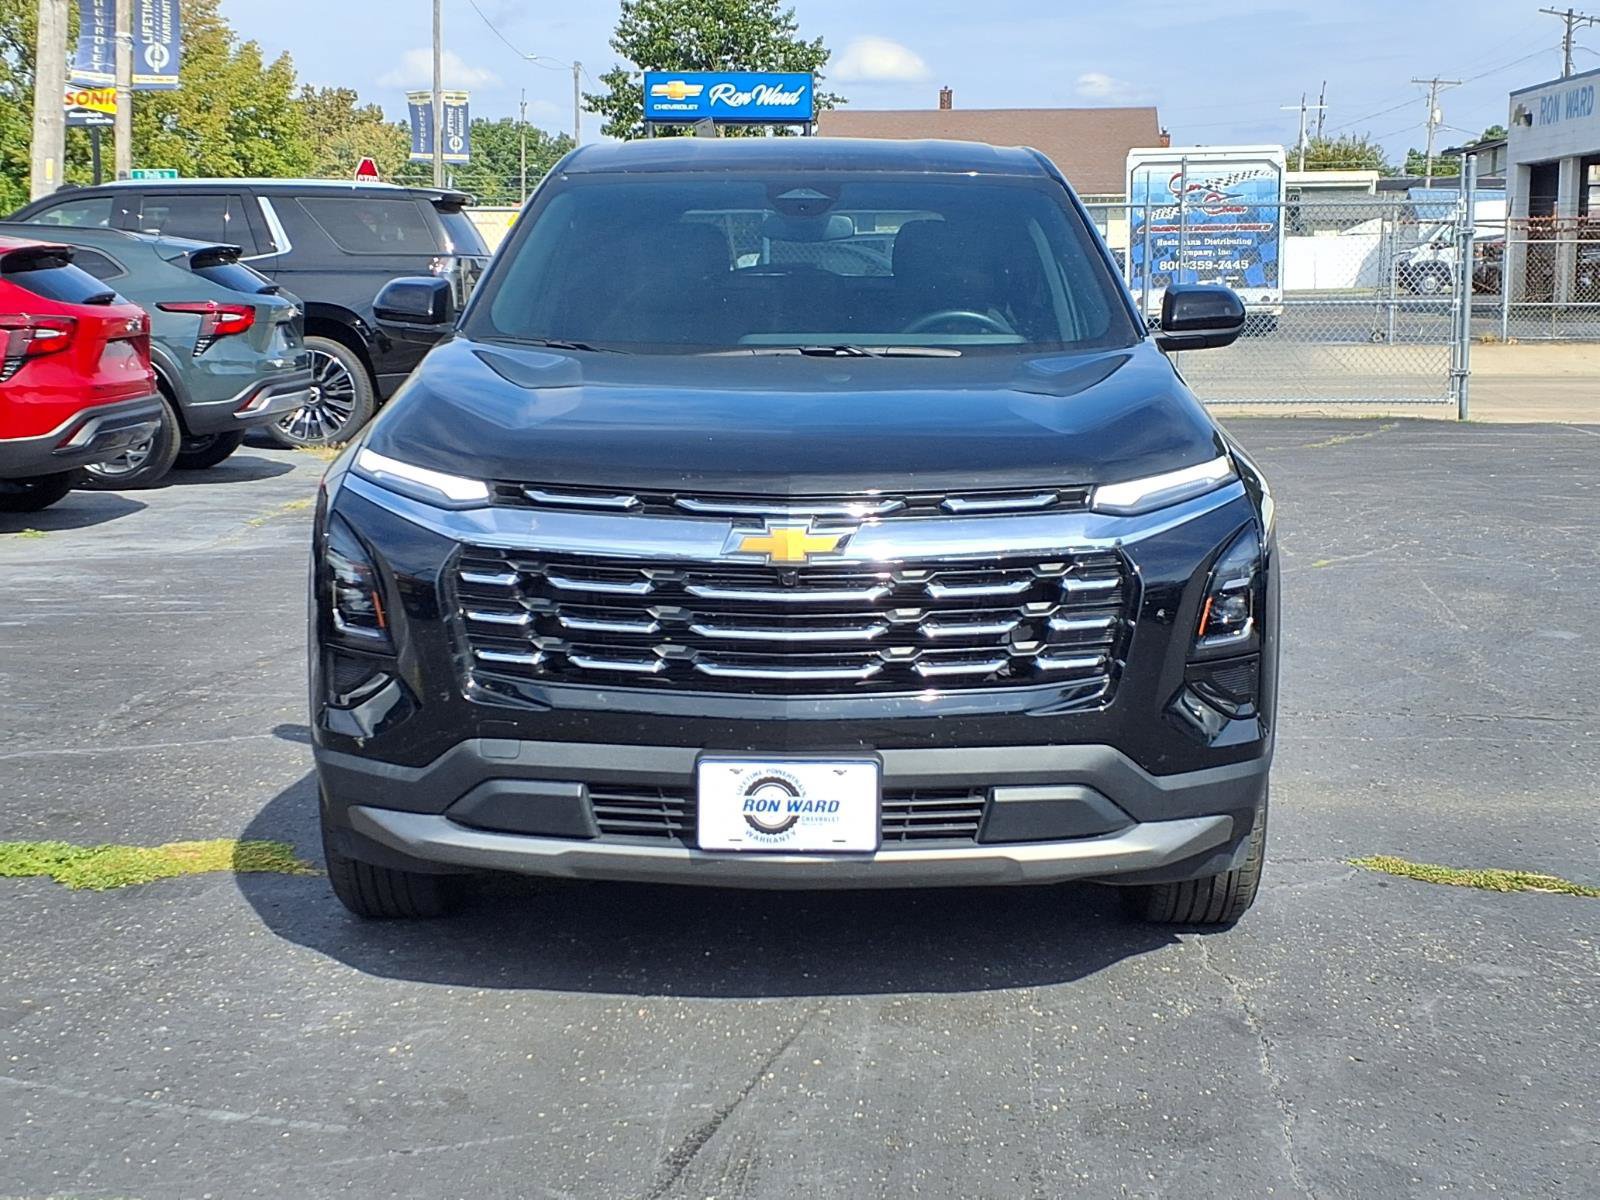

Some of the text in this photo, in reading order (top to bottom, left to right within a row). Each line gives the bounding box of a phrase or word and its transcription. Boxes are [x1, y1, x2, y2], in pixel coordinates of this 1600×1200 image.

[709, 83, 806, 107] Ron Ward
[1539, 85, 1594, 126] RON WARD
[743, 799, 840, 813] RON WARD
[745, 829, 797, 844] WARRANTY
